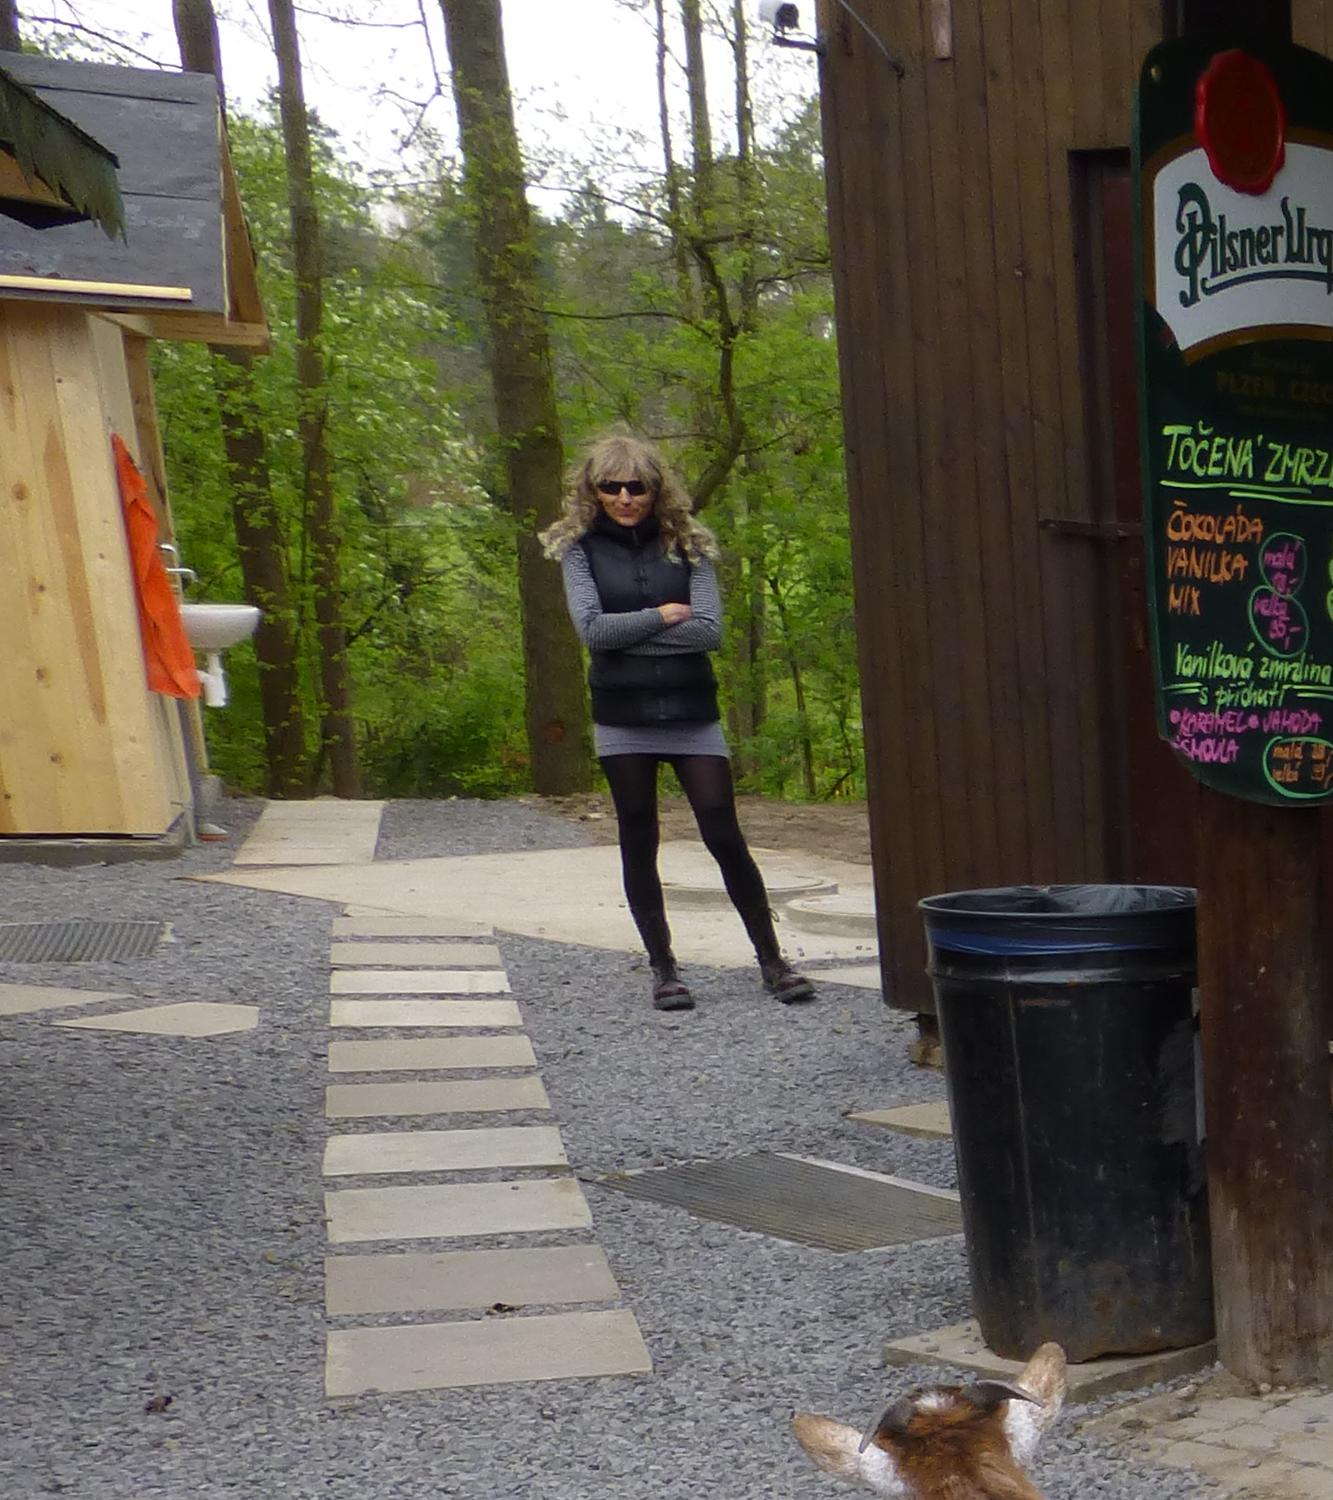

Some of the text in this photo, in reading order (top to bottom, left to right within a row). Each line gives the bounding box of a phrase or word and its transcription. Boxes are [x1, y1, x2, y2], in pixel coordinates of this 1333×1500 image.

[1175, 182, 1284, 308] Pilsner
[1162, 420, 1263, 479] TOČENÁ
[1166, 499, 1264, 543] ČOKOLÁDA
[1167, 546, 1248, 584] VANILKA
[1168, 583, 1202, 616] MIX
[1176, 640, 1255, 680] Vanilková
[1199, 685, 1210, 707] s
